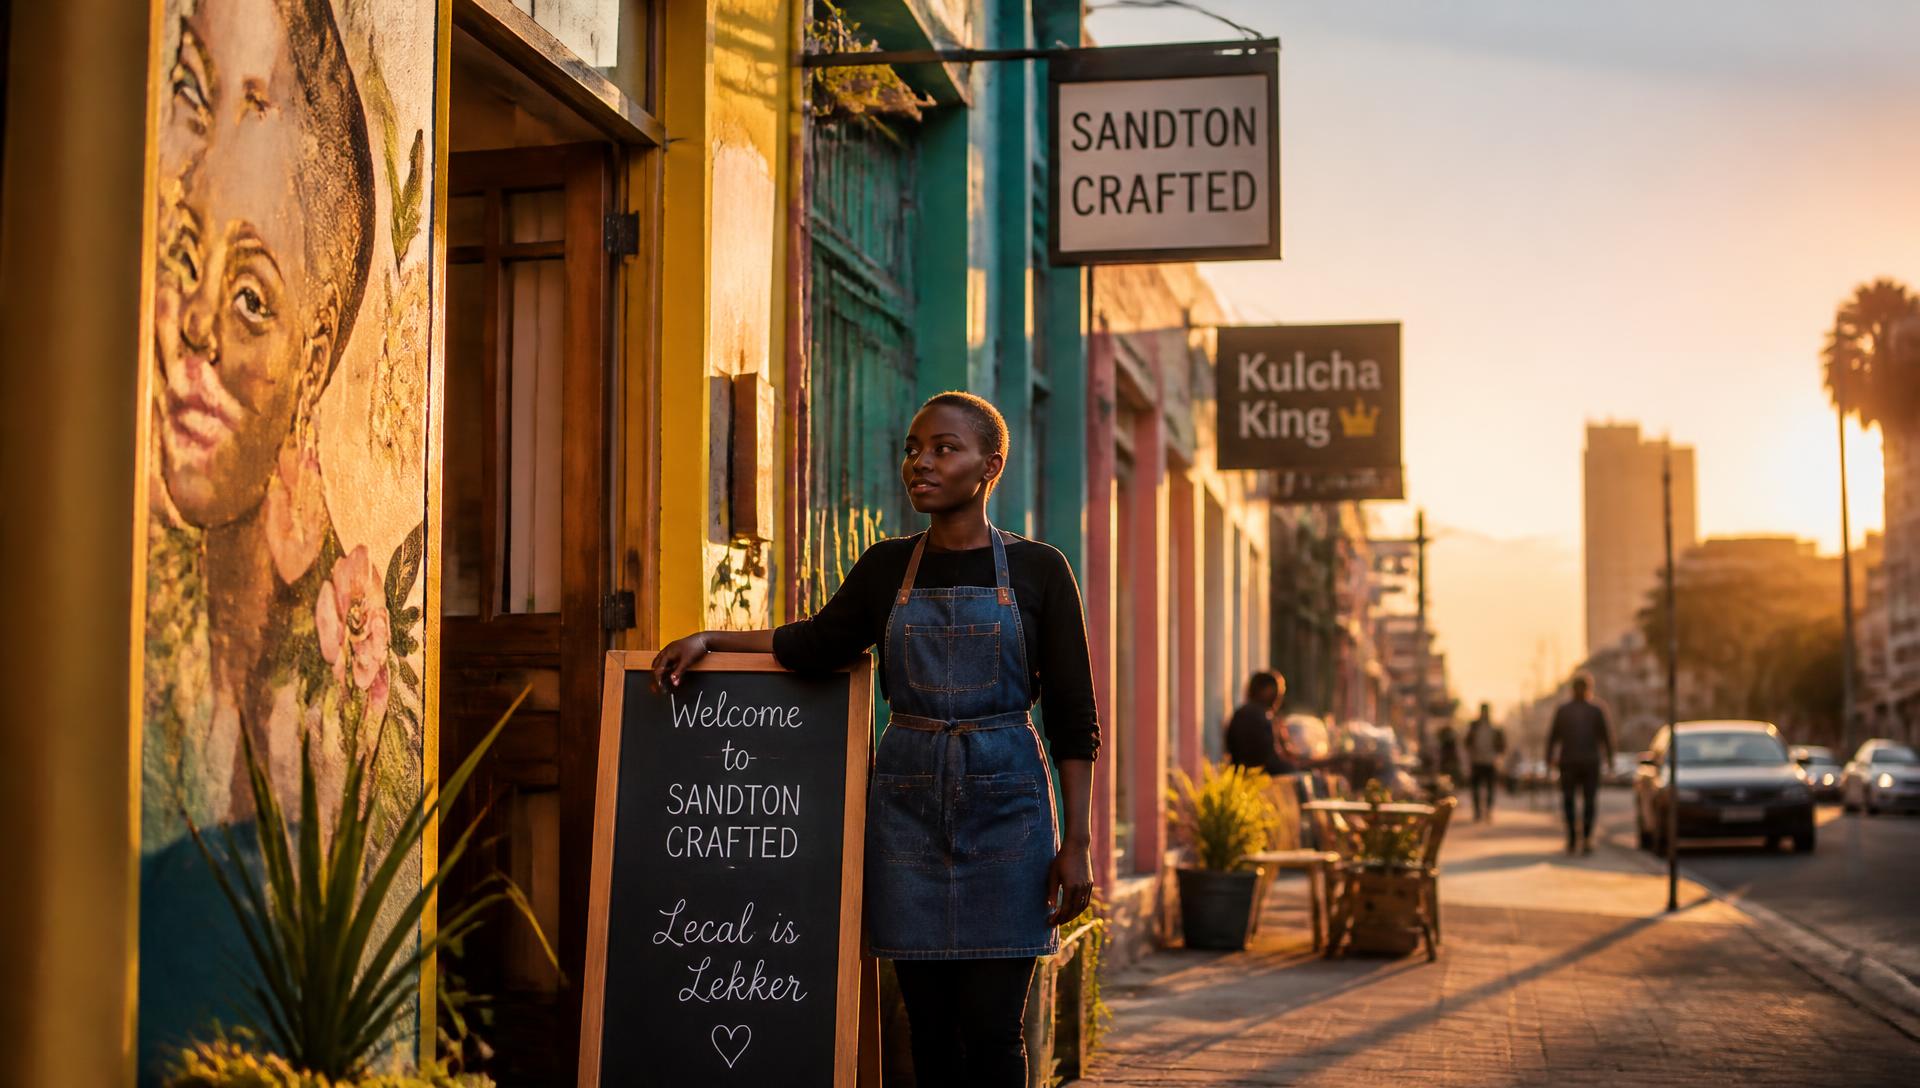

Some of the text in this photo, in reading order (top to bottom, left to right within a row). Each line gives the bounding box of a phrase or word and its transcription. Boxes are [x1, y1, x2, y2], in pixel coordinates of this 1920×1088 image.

[1071, 106, 1257, 152] SANDTON
[1072, 170, 1257, 216] CRAFTED
[1238, 350, 1382, 393] Kulcha
[1239, 400, 1331, 447] King
[671, 690, 803, 728] Welcome
[666, 783, 801, 816] SANDTON
[666, 825, 798, 858] CRAFTED
[769, 912, 801, 944] is
[678, 956, 808, 1003] Lekker
